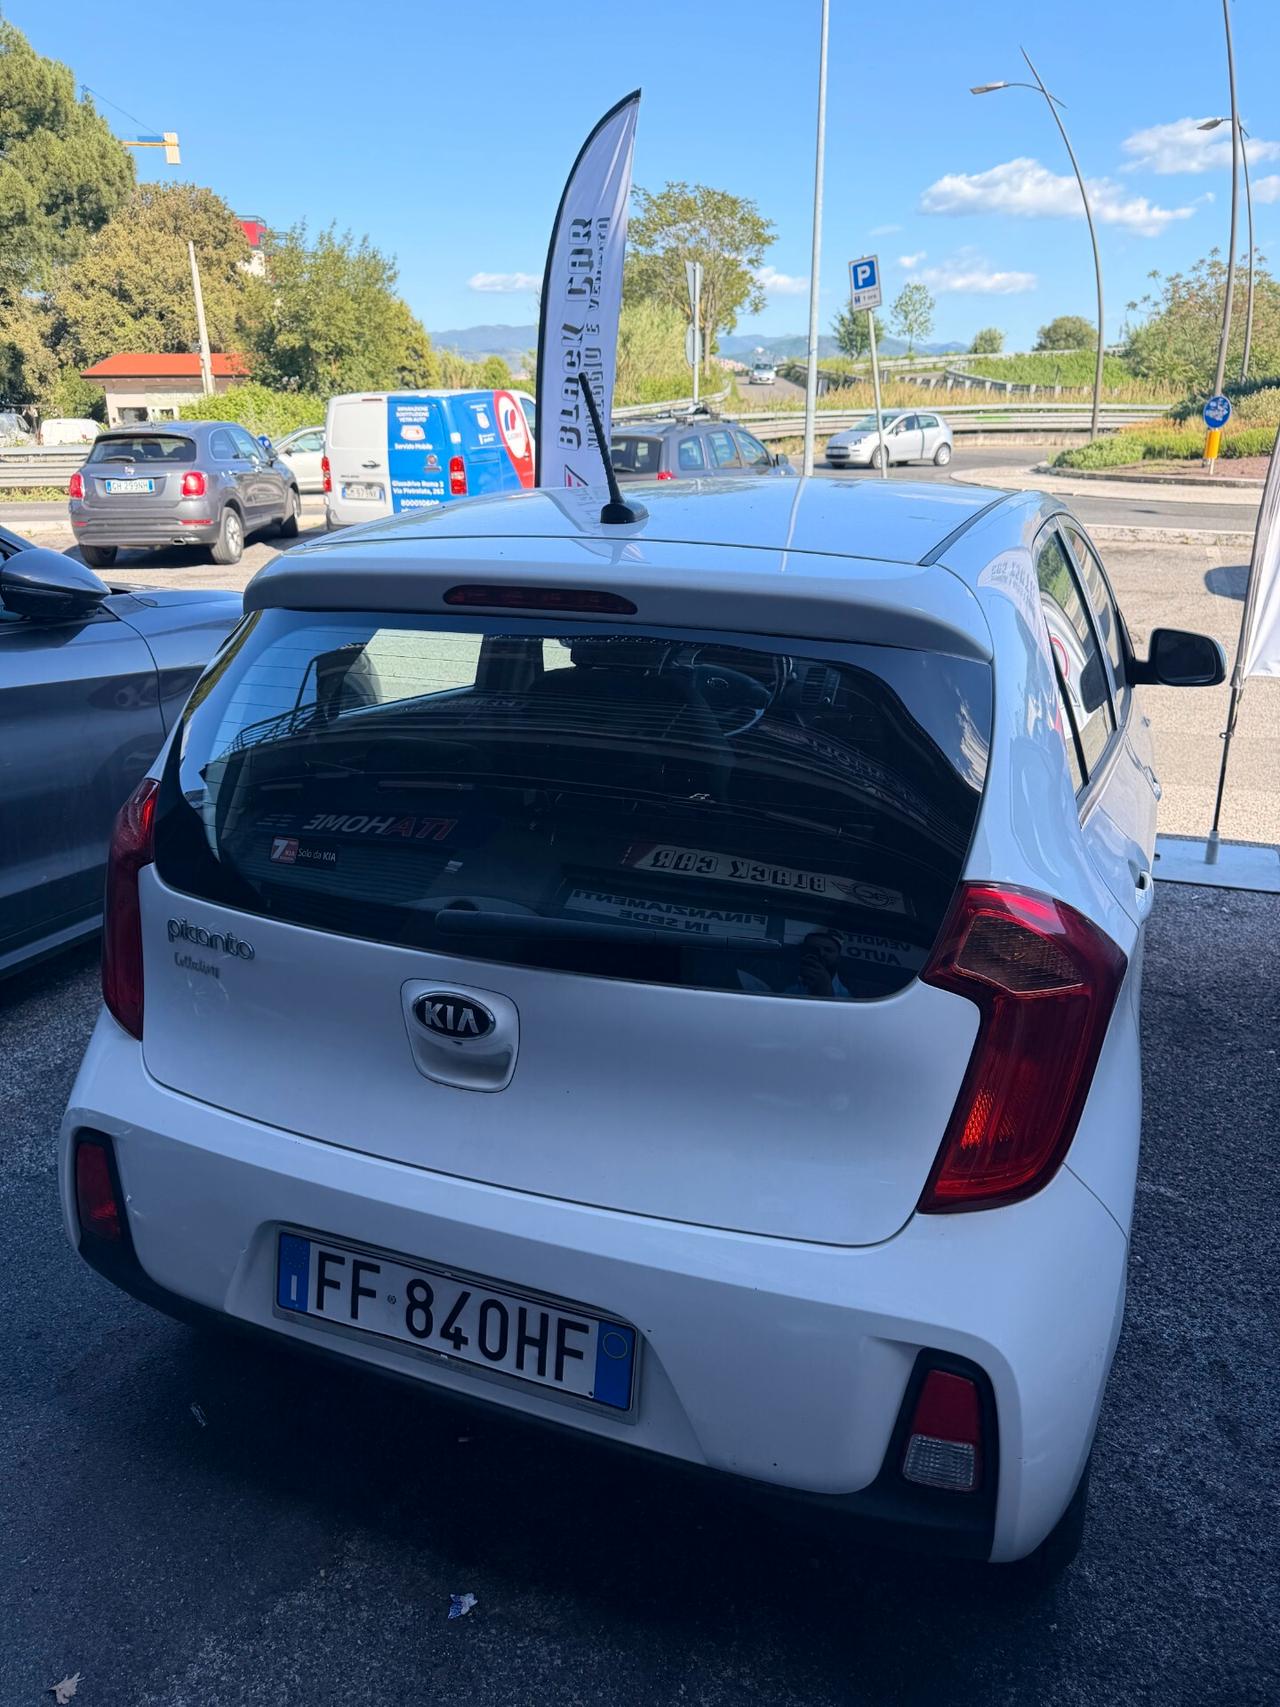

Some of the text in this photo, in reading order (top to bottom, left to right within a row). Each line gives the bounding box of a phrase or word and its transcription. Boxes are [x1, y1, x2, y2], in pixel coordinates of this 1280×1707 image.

[857, 265, 871, 287] P
[557, 216, 593, 451] BLACK CAR
[585, 324, 600, 336] E
[271, 838, 289, 860] 7
[297, 848, 312, 859] Solo
[323, 851, 336, 863] KIA
[166, 917, 256, 961] picanto
[424, 999, 481, 1035] KIA
[316, 1250, 590, 1383] FF 840HF
